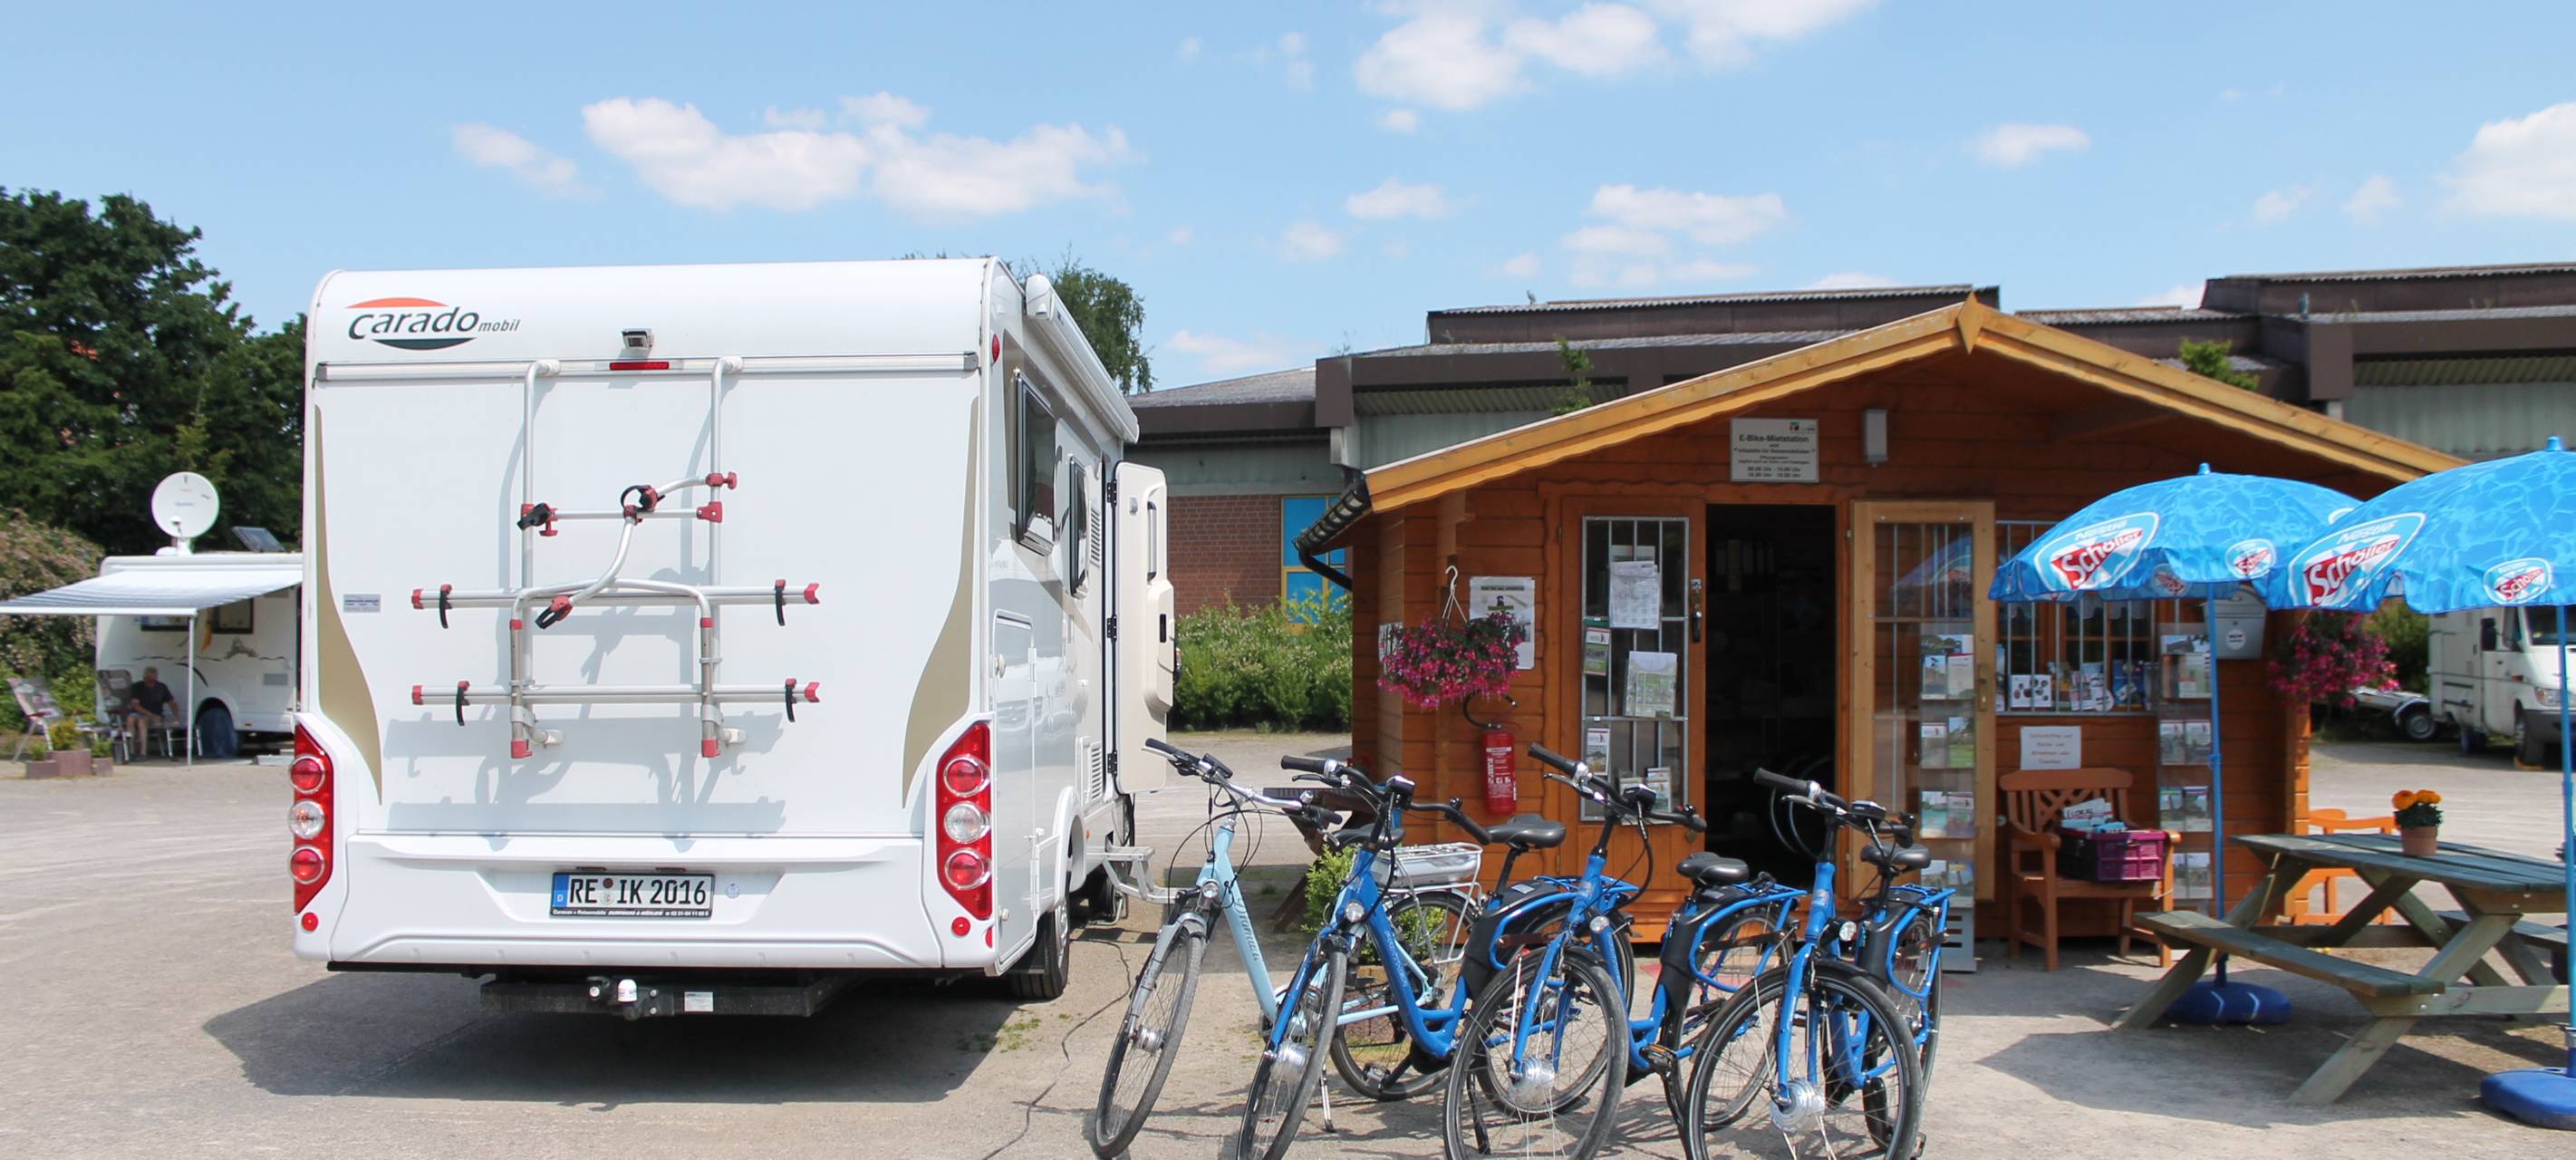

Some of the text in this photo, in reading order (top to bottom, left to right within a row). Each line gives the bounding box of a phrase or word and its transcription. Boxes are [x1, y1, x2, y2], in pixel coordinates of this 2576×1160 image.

[348, 306, 522, 341] carado mobil
[1739, 434, 1810, 443] E-Bike-Mietstation
[2310, 541, 2395, 605] Schöller
[556, 894, 564, 903] D
[569, 878, 707, 905] RE IK 2016
